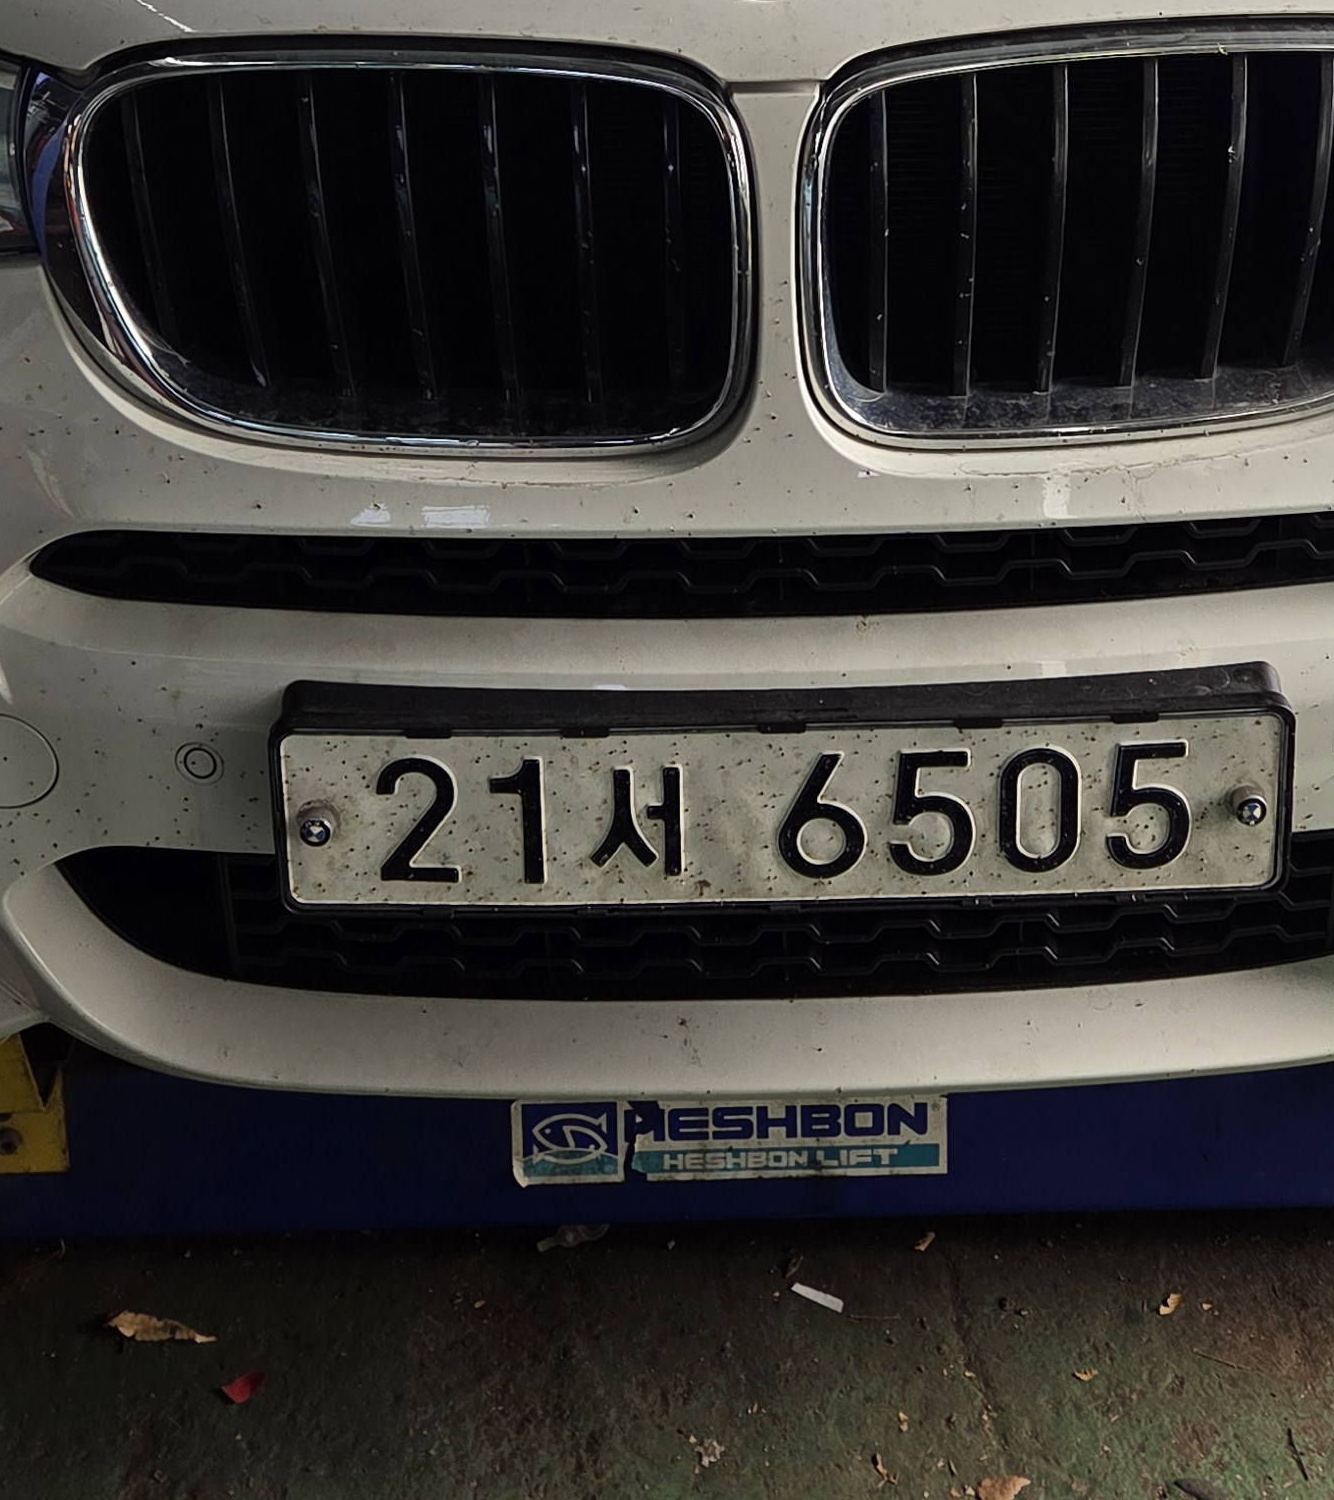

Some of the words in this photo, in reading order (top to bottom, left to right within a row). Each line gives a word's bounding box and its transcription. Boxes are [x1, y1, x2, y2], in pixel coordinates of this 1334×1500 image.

[375, 757, 684, 884] 21서
[778, 741, 1193, 879] 6505
[663, 1149, 809, 1171] HESHBON
[816, 1147, 899, 1167] LIFT
